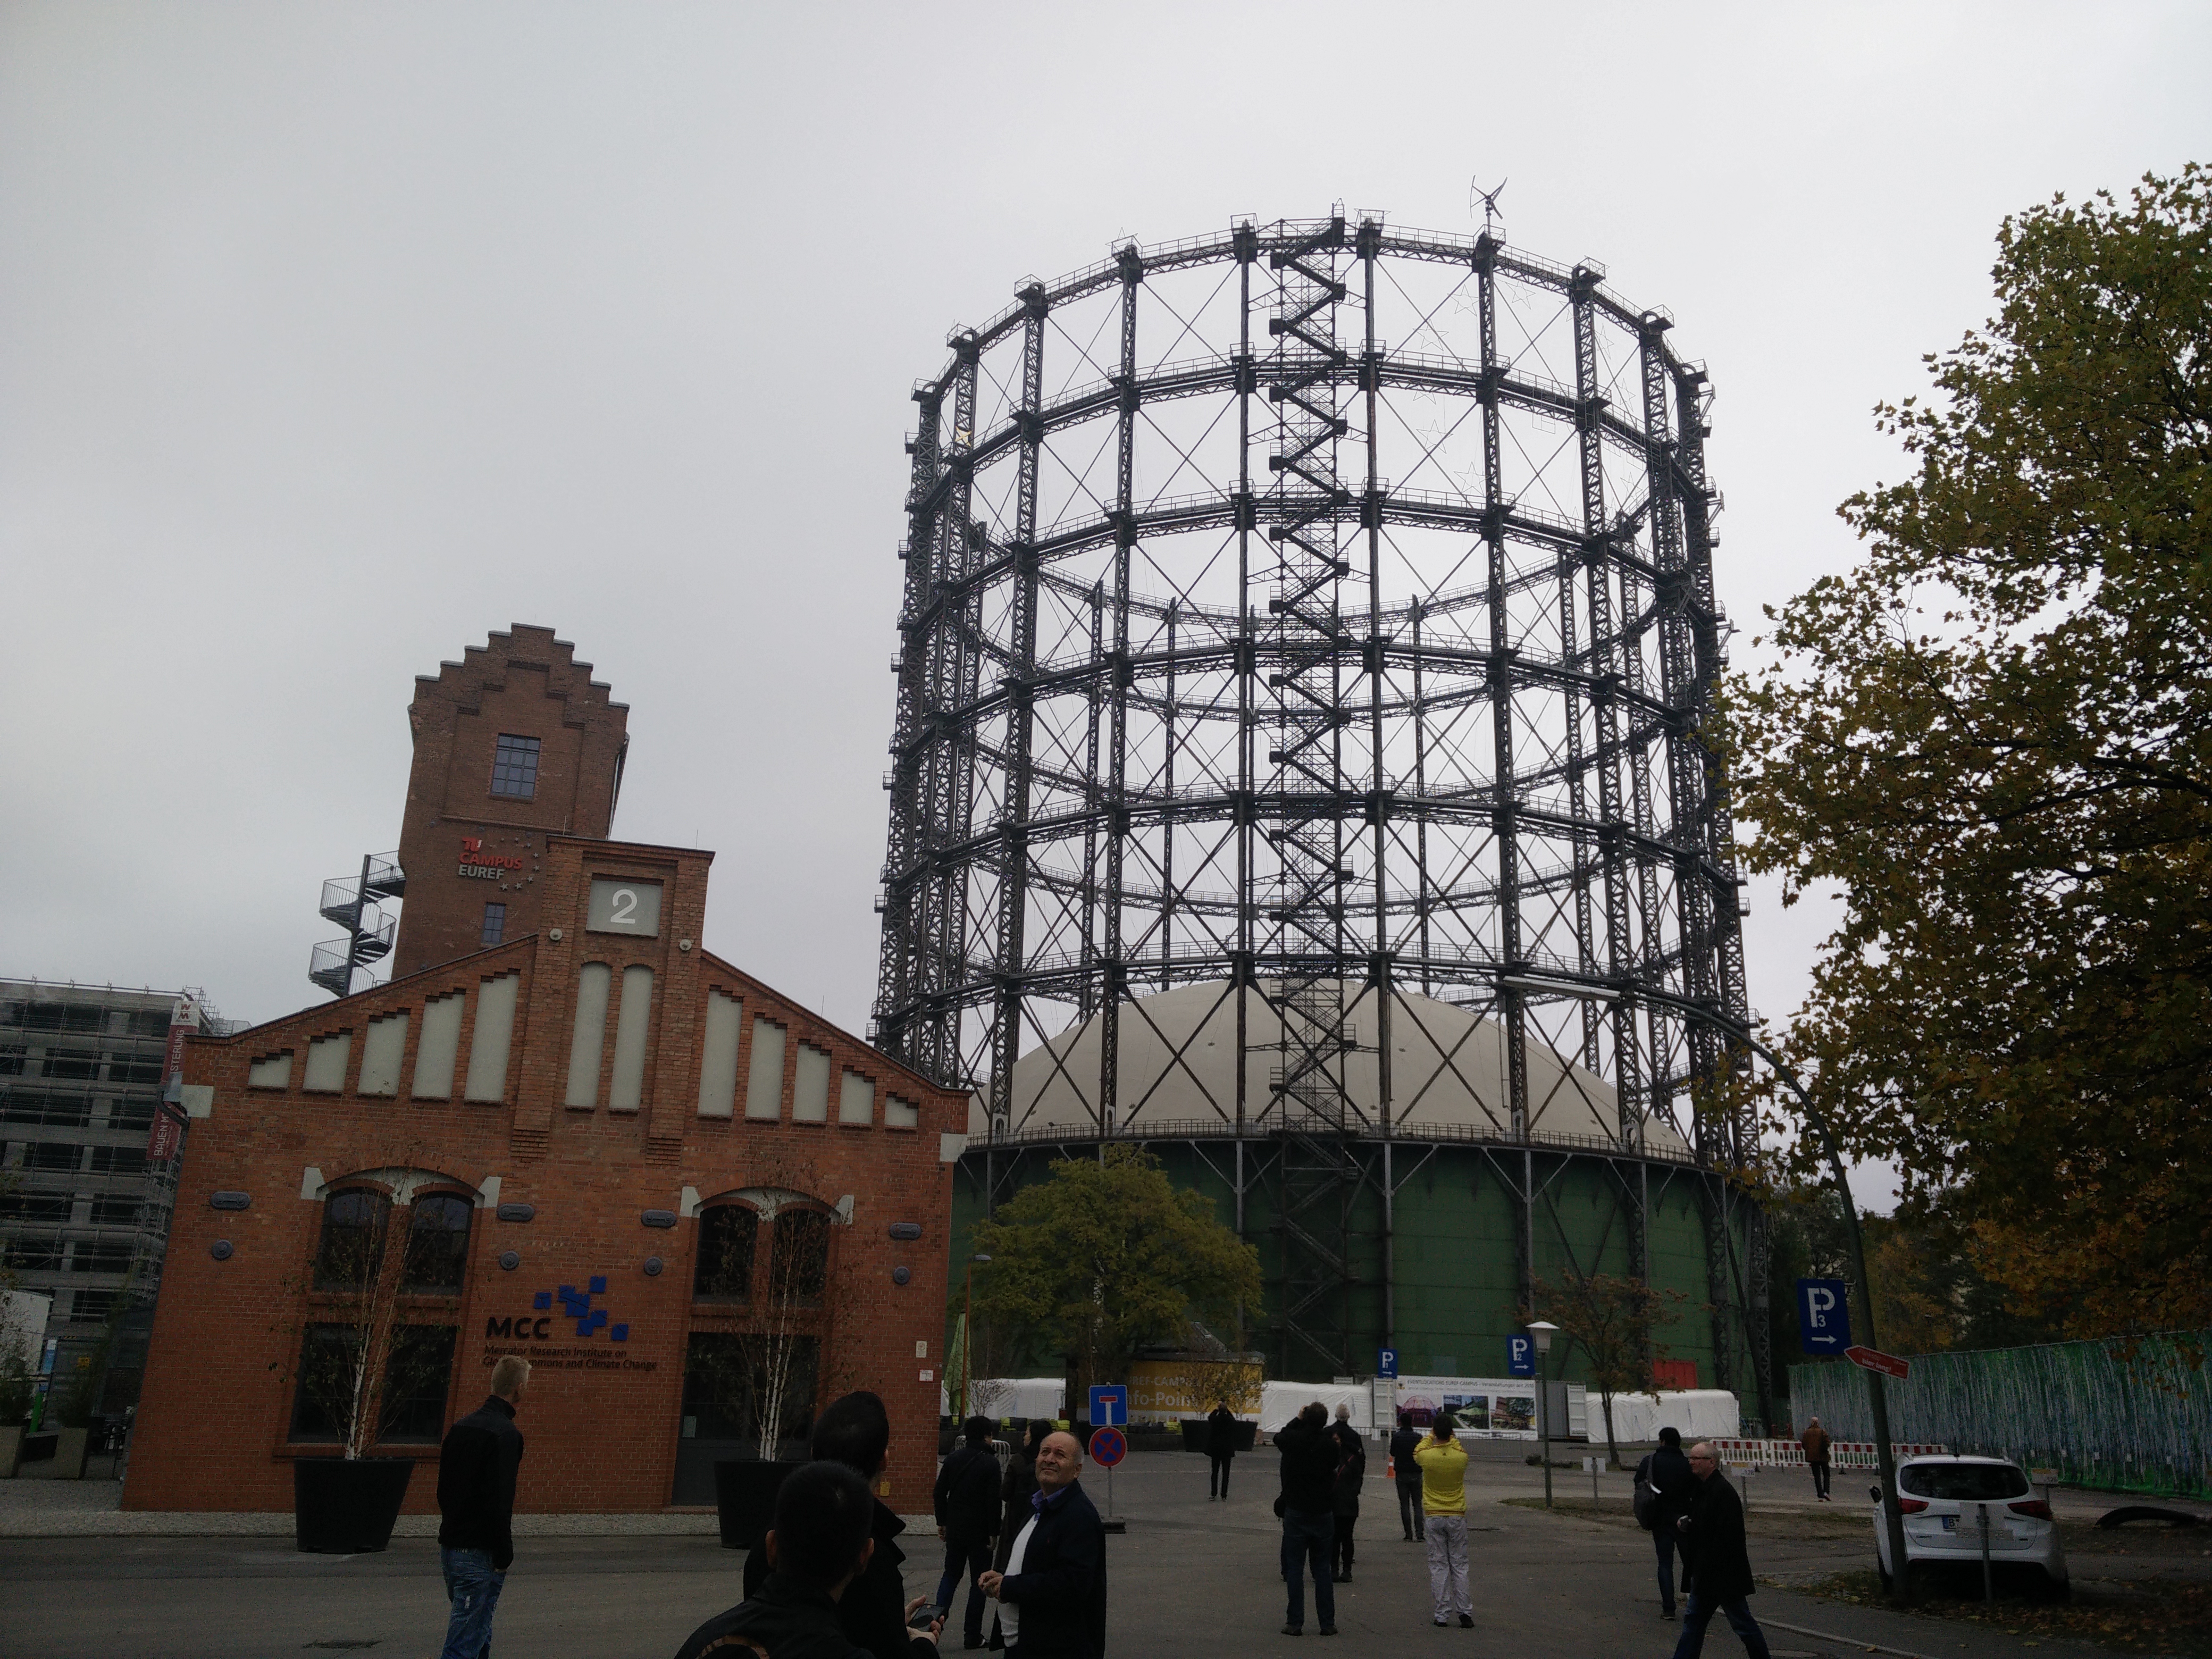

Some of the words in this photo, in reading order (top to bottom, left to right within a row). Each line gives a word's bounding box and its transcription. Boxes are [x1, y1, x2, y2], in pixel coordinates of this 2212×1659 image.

[462, 837, 482, 852] TU
[459, 852, 522, 869] CAMPUS
[458, 865, 505, 880] EUREF
[610, 889, 638, 924] 2
[154, 1125, 169, 1157] BAUEN
[170, 1029, 185, 1072] STERUNG
[485, 1317, 551, 1339] MCC
[484, 1345, 527, 1355] Mercator
[530, 1346, 571, 1356] Research
[574, 1347, 612, 1357] Institute
[483, 1356, 500, 1367] Glo
[529, 1359, 563, 1368] mmons
[565, 1359, 583, 1368] and
[586, 1359, 620, 1369] Climate
[623, 1360, 657, 1371] Change
[1128, 1389, 1199, 1408] nfo-Point
